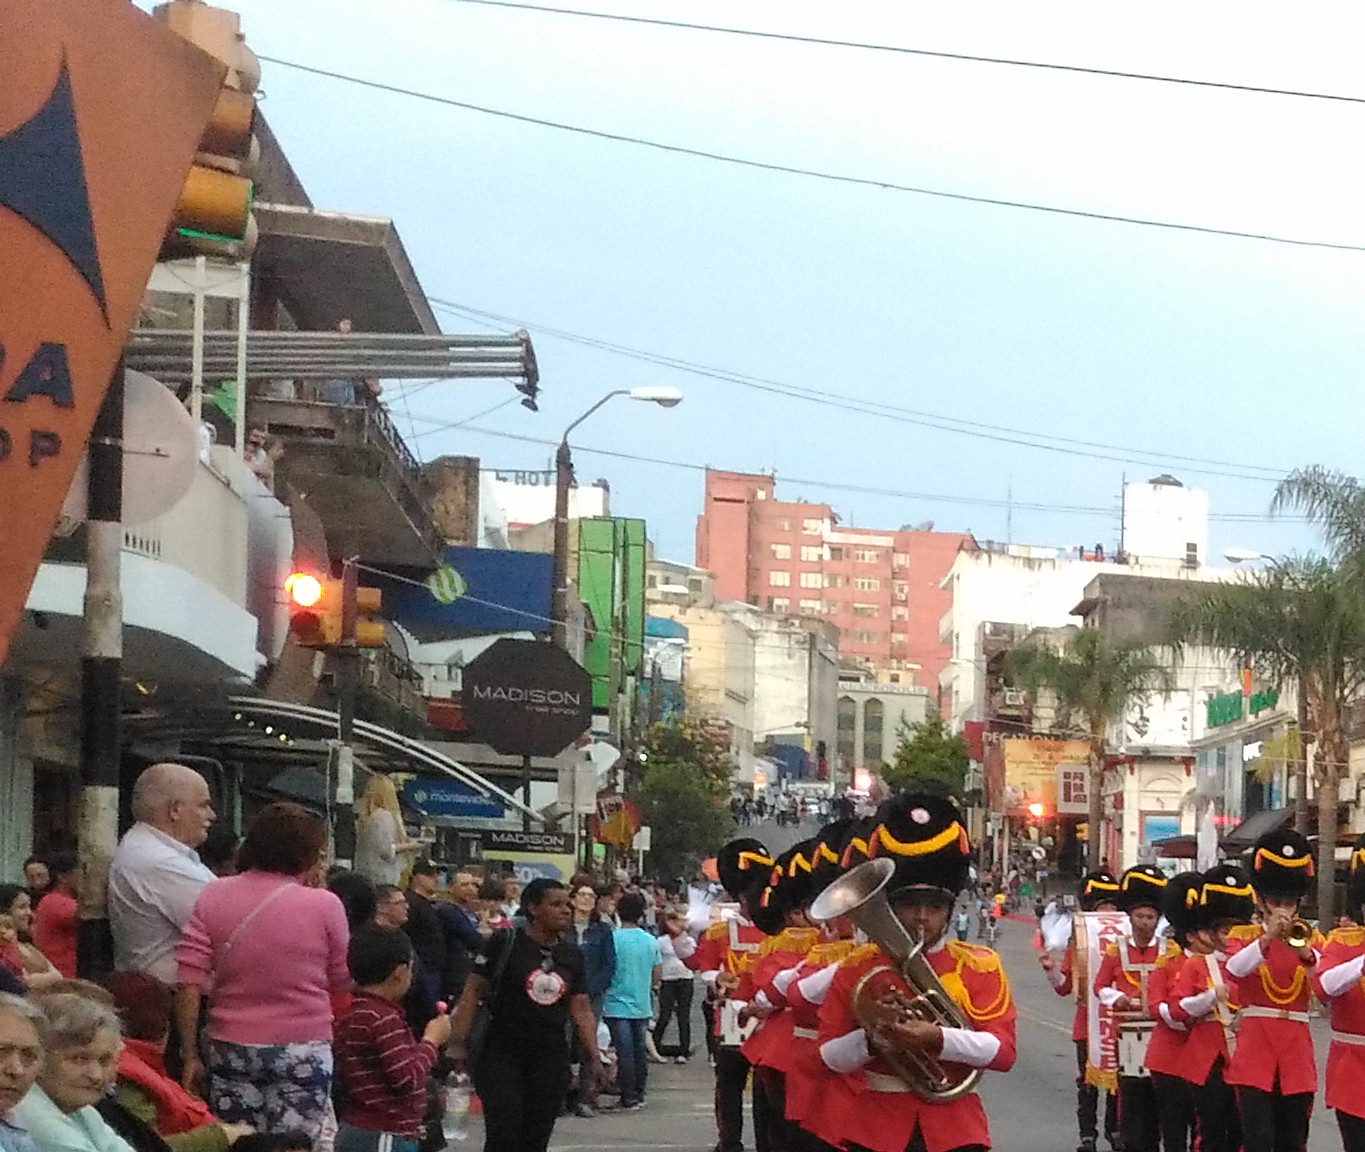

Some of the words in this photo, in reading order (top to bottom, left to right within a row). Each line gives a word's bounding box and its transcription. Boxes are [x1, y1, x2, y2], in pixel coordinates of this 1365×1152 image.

[0, 341, 75, 408] A
[473, 685, 580, 706] MADISON
[492, 831, 565, 846] MADISON
